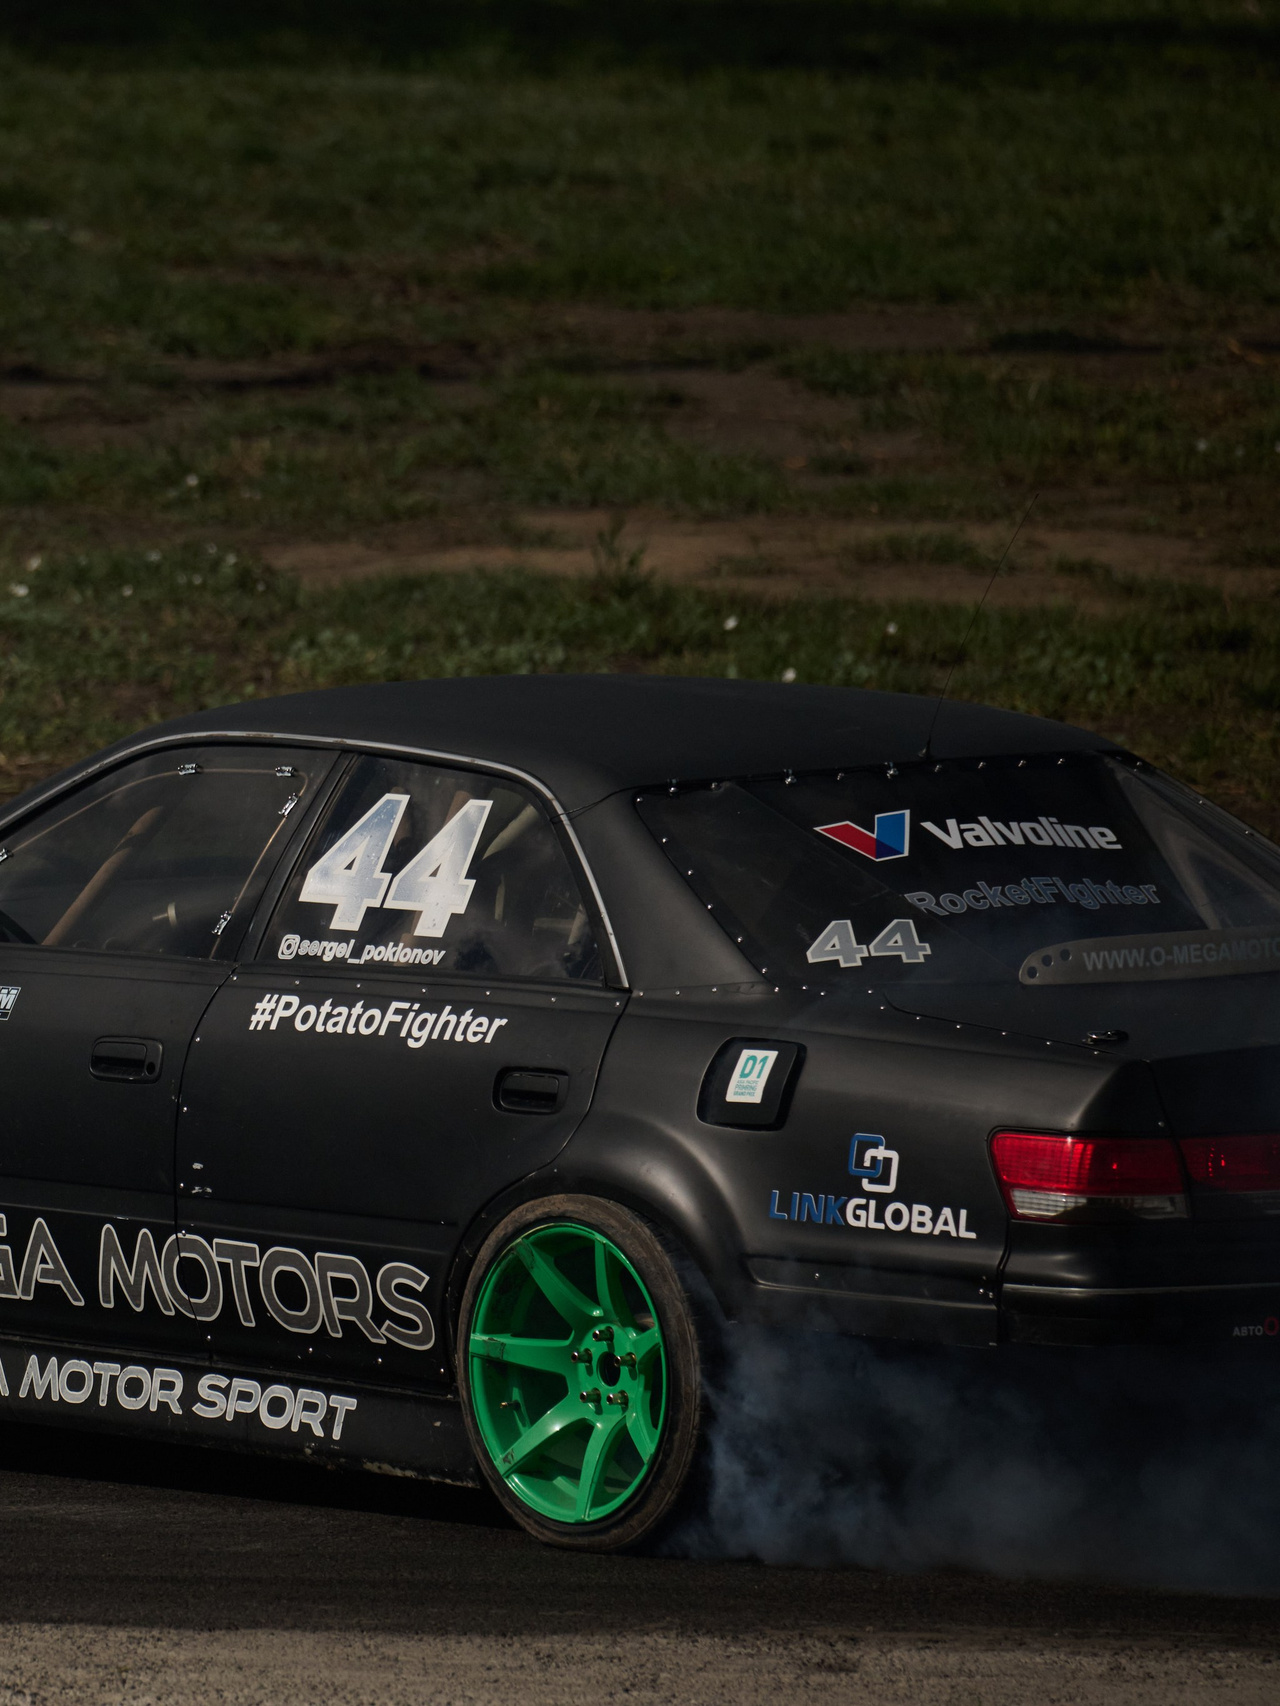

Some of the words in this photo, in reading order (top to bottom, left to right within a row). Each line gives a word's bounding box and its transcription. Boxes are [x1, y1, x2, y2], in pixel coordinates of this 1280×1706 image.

[920, 815, 1123, 850] Valvoline
[299, 793, 493, 938] 44
[903, 876, 1161, 916] RocketFighter
[806, 919, 932, 968] 44
[249, 994, 508, 1048] #PotatoFighter
[739, 1055, 769, 1079] D1
[98, 1223, 436, 1351] MOTORS
[19, 1354, 184, 1415] MOTOR
[192, 1374, 358, 1440] SPORT
